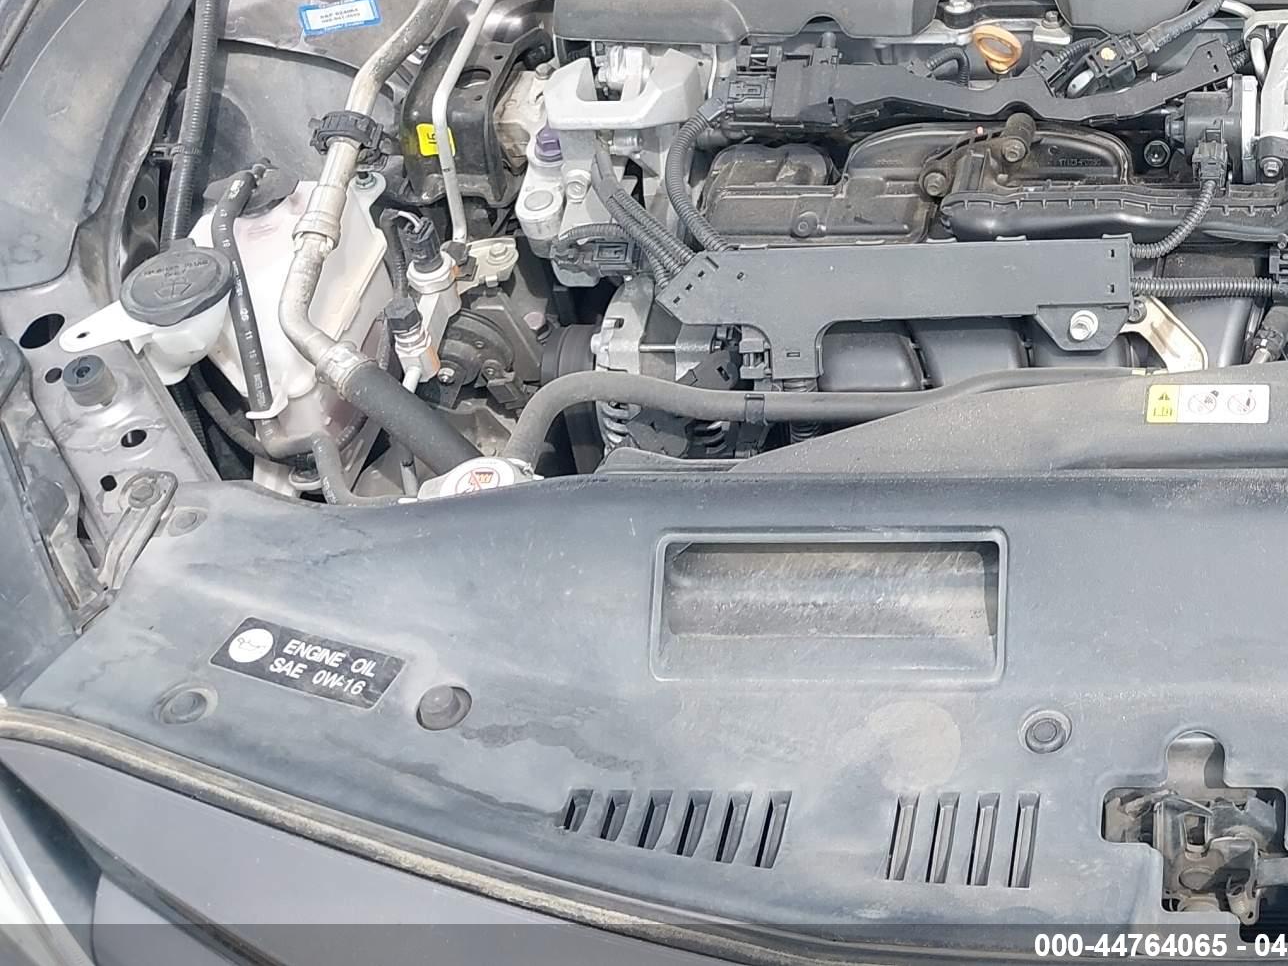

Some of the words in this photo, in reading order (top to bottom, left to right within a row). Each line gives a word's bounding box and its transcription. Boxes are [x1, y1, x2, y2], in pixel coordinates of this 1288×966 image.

[269, 657, 308, 679] SAE
[312, 670, 367, 694] 0W-16
[283, 638, 347, 667] ENGINE
[350, 658, 377, 678] OIL
